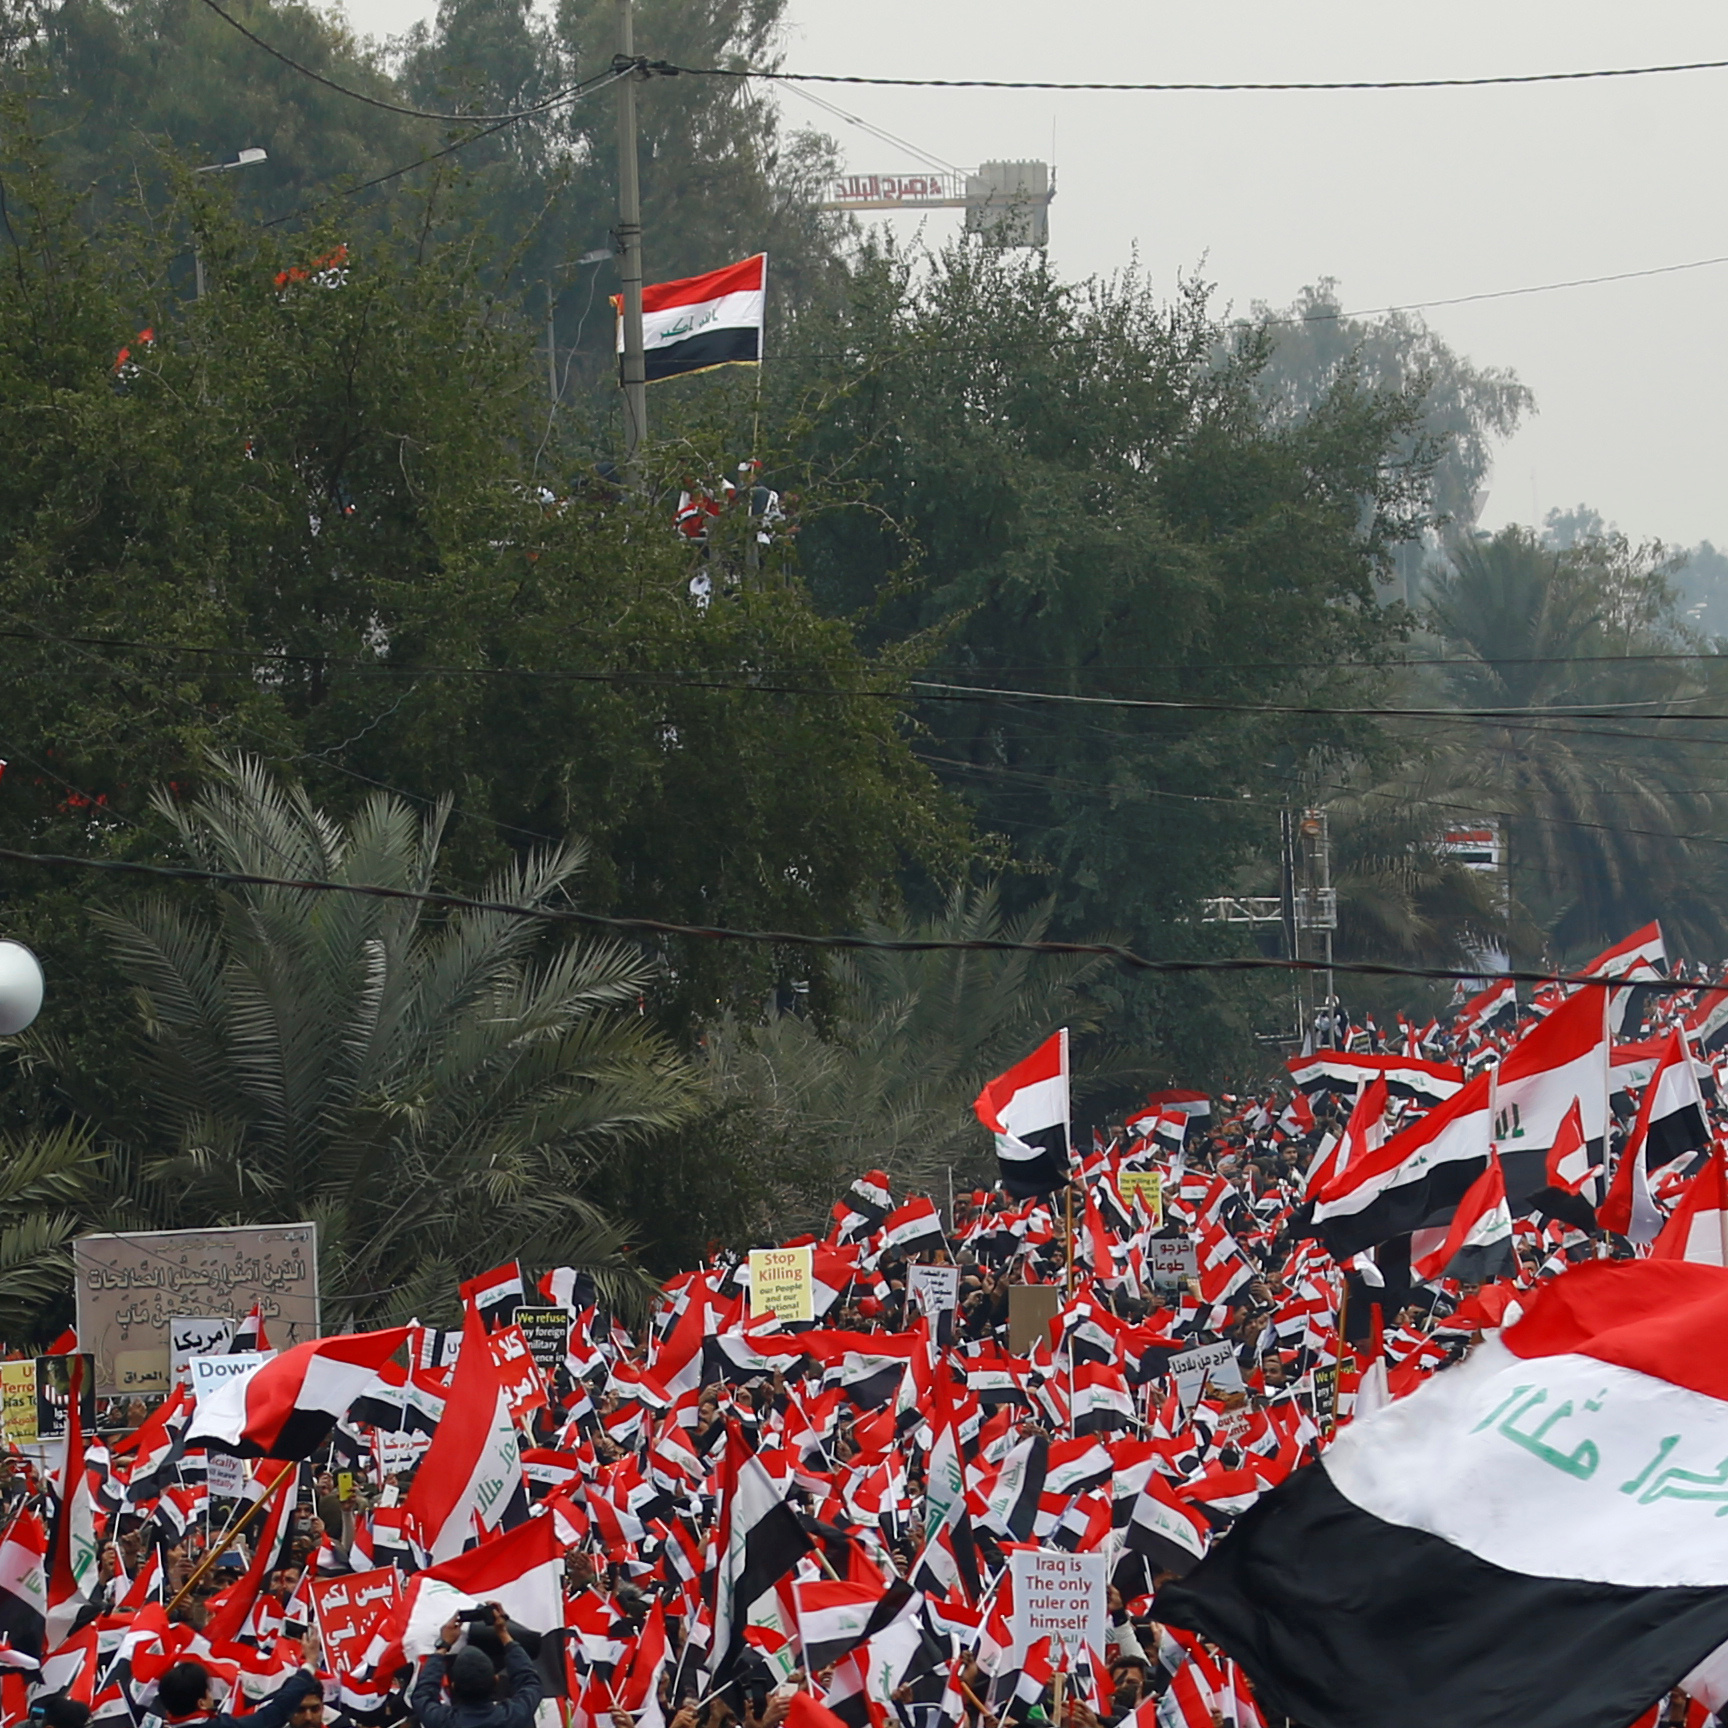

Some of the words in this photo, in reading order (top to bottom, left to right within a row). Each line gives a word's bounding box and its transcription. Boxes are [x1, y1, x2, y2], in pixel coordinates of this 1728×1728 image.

[765, 1253, 796, 1266] Stop
[759, 1267, 803, 1282] Killing
[775, 1283, 803, 1294] People
[783, 1293, 797, 1301] our
[765, 1302, 799, 1312] National
[517, 1314, 534, 1323] We
[536, 1313, 567, 1323] refuse
[535, 1326, 566, 1338] foreign
[198, 1360, 257, 1378] Down
[1036, 1557, 1066, 1576] Iraq
[1070, 1557, 1082, 1571] is
[1026, 1575, 1053, 1590] The
[1058, 1577, 1093, 1594] only
[1029, 1596, 1065, 1609] ruler
[1069, 1599, 1089, 1610] on
[1030, 1613, 1089, 1629] himself
